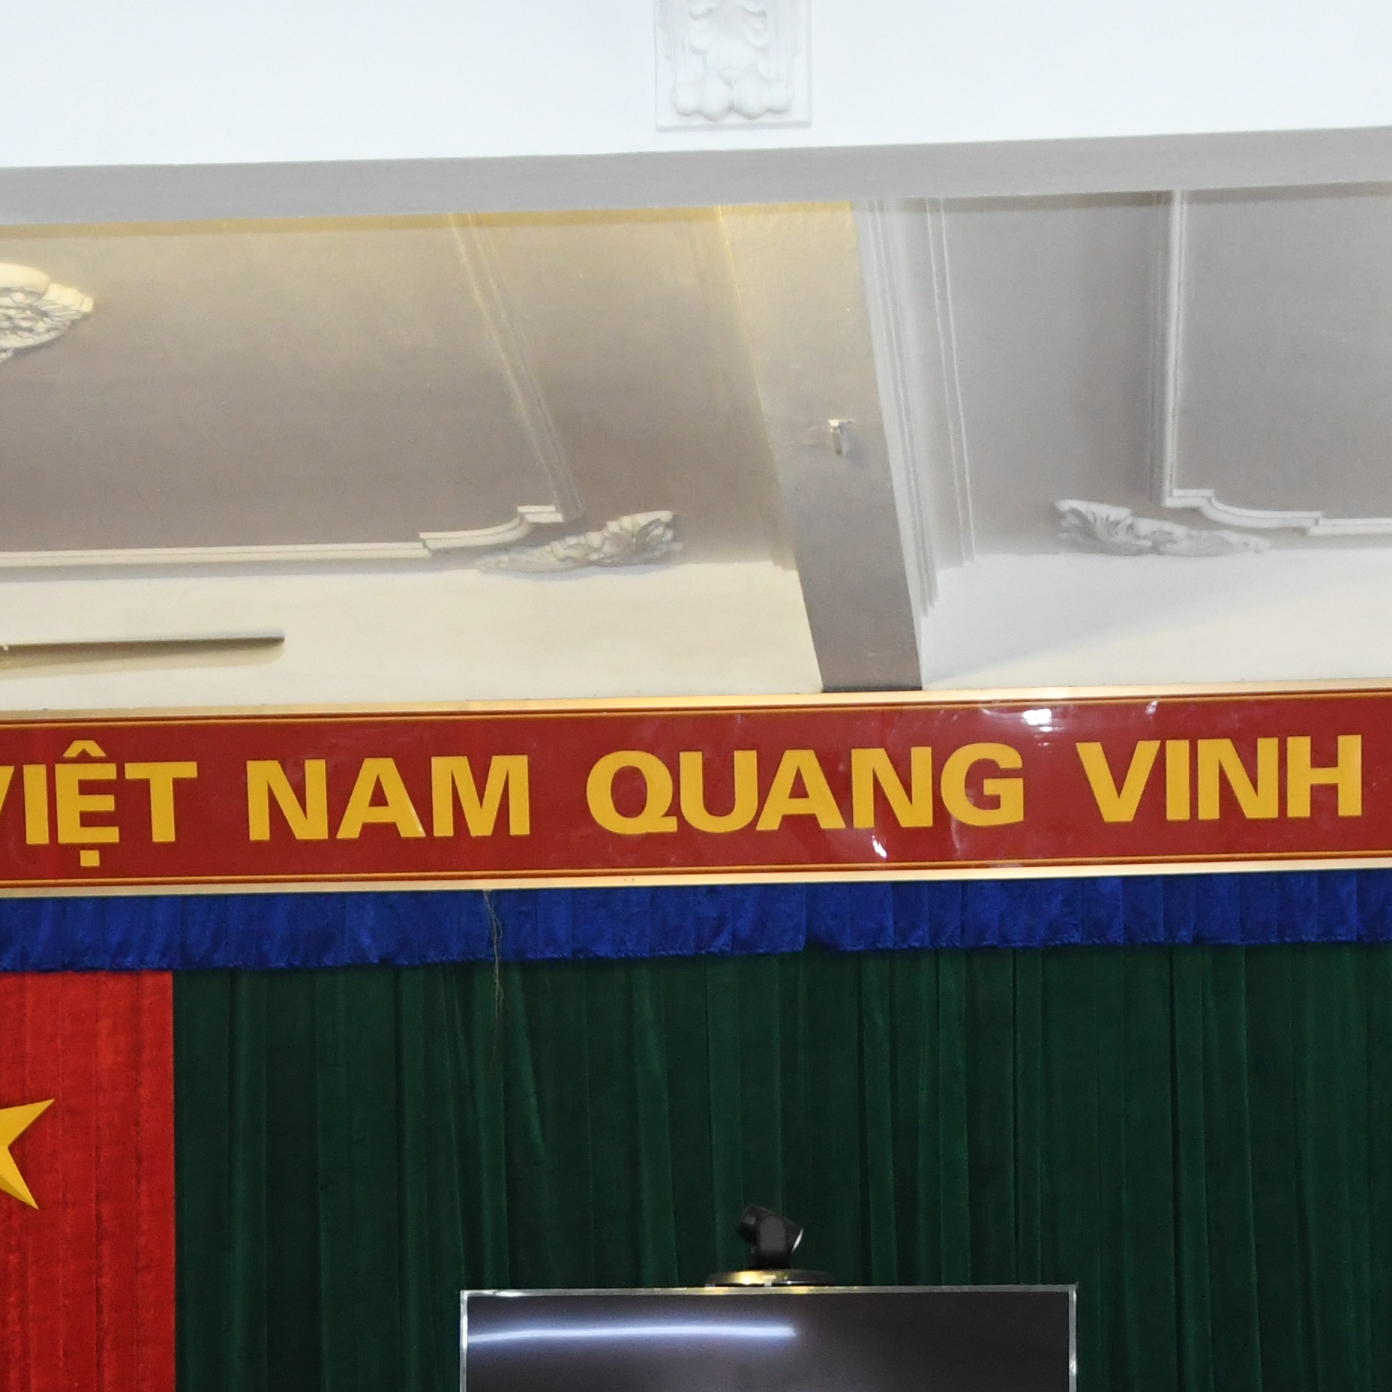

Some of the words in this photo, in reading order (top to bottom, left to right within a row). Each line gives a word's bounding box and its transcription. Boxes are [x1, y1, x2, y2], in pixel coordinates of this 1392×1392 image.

[246, 754, 531, 841] NAM
[585, 742, 1024, 835] QUANG
[1075, 734, 1363, 823] VINH
